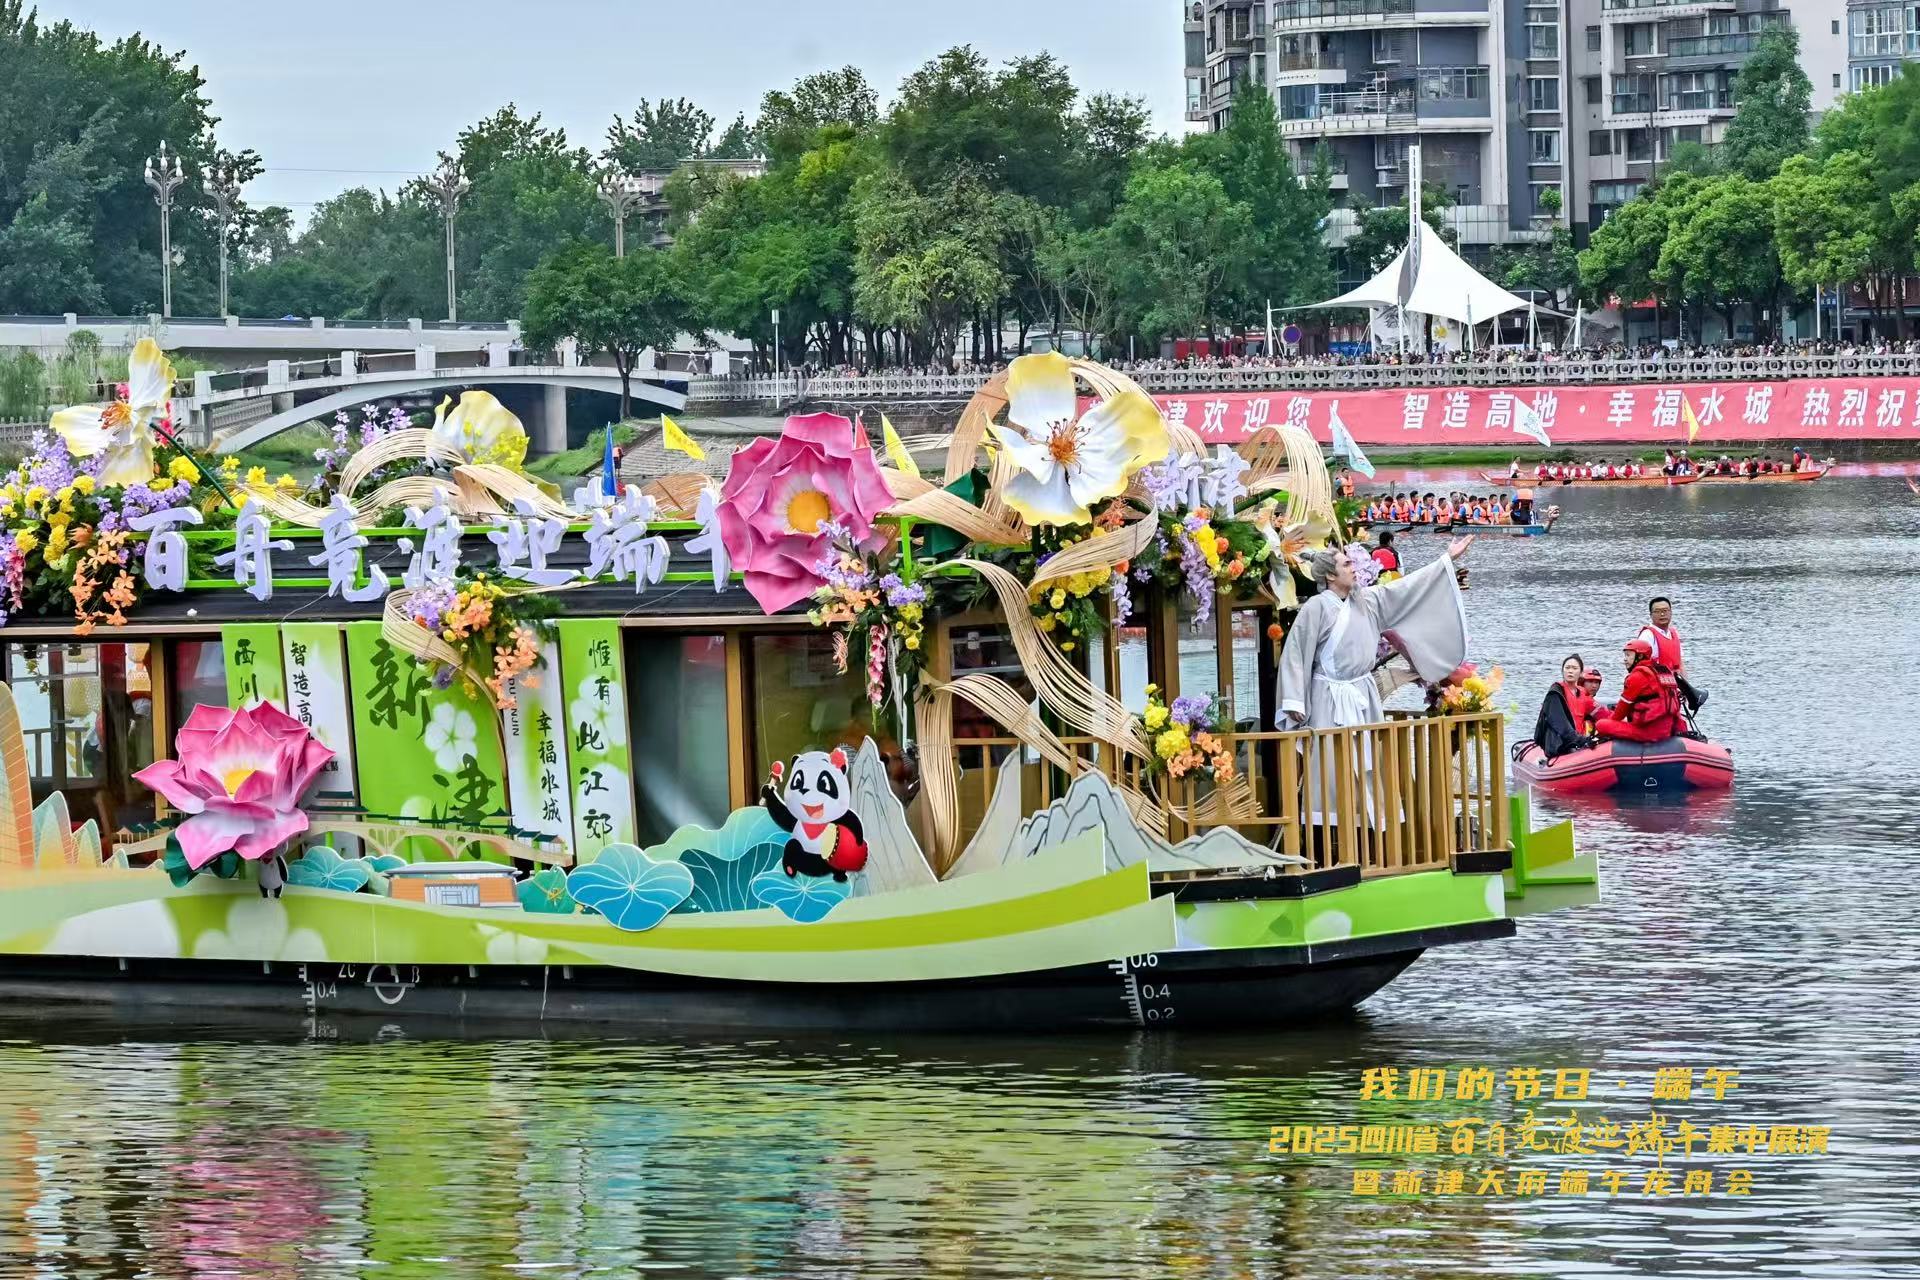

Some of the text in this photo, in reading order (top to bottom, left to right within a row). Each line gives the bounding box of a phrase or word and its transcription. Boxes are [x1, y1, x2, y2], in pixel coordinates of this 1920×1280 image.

[1155, 444, 1250, 519] 新津
[234, 638, 258, 702] 西川
[536, 710, 562, 823] 幸福水城
[575, 639, 614, 846] 惟有此江郊
[317, 982, 336, 998] 0.4
[1142, 983, 1171, 999] 0.4
